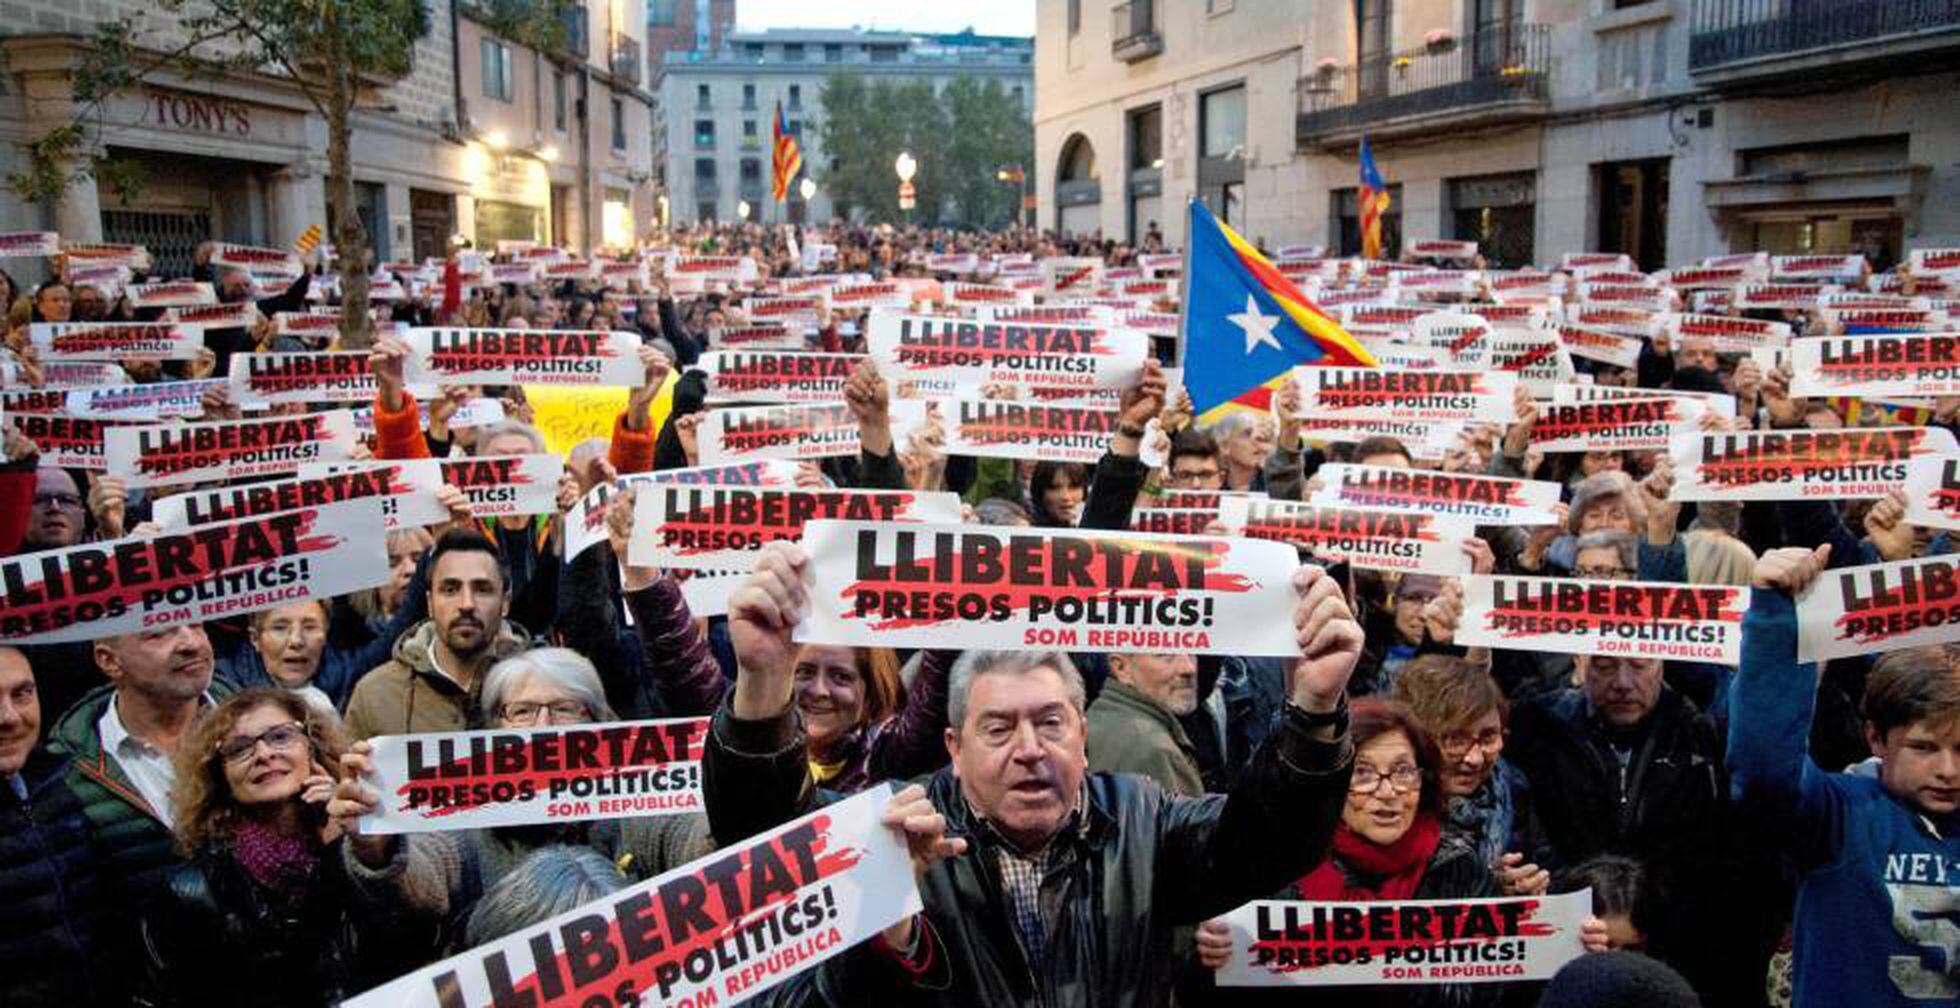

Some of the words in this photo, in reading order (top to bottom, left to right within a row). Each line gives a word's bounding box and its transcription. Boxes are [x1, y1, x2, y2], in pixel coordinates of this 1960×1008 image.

[150, 93, 250, 135] TONY'S
[431, 332, 606, 357] LLIBERTAT
[901, 319, 1096, 353] LLIBERTAT
[431, 356, 510, 371] PRESOS
[513, 356, 602, 373] POLÍTICS!
[900, 349, 985, 367] PRESOS
[991, 351, 1096, 373] POLÍTICS!
[1319, 369, 1474, 393] LLIBERTAT
[1319, 392, 1388, 407] PRESOS
[1394, 394, 1477, 410] POLÍTICS!
[139, 418, 318, 456] LLIBERTAT
[723, 435, 790, 450] PRESOS
[1588, 424, 1670, 440] POLÍTICS!
[1702, 430, 1916, 464] LLIBERTAT
[139, 452, 223, 474] PRESOS
[229, 442, 320, 466] POLÍTICS!
[1701, 466, 1793, 484] PRESOS
[185, 467, 397, 527] LLIBERTAT
[1342, 470, 1514, 504] LLIBERTAT
[664, 488, 903, 528] LLIBERTAT
[1246, 503, 1426, 539] LLIBERTAT
[1420, 498, 1512, 519] POLÍTICS!
[664, 529, 763, 553] PRESOS
[1326, 539, 1423, 558] POLÍTICS!
[0, 514, 303, 604] LIBERTAT
[856, 528, 1212, 590] LLIBERTAT
[144, 558, 311, 611] POLÍTICS!
[1494, 579, 1727, 620] LLIBERTAT
[1841, 562, 1960, 612] LLIB
[144, 604, 193, 628] SOM
[200, 584, 312, 615] REPÚBLICA
[854, 590, 1013, 622] PRESOS
[1030, 588, 1216, 627] POLÍTICS!
[1024, 628, 1078, 645] SOM
[1089, 627, 1211, 648] REPÚBLICA
[1493, 614, 1588, 634] PRESOS
[1599, 616, 1727, 644] POLÍTICS!
[1597, 640, 1634, 652] SOM
[1638, 641, 1724, 658] REPÚBLICA
[405, 720, 702, 780] LLIBERTAT
[409, 780, 537, 810] PRESOS
[548, 762, 699, 800] POLÍTICS!
[548, 798, 593, 817] SOM
[600, 792, 698, 813] REPÚBLICA
[430, 822, 820, 1008] LLIBERTAT
[1256, 901, 1528, 940] LLIBERTAT
[655, 884, 839, 998] POLÍTICS!
[1256, 944, 1372, 966] PRESOS
[1388, 939, 1526, 965] POLÍTICS!
[726, 925, 843, 997] REPÚBLICA
[1382, 966, 1423, 979] SOM
[1429, 963, 1525, 978] REPÚBLICA
